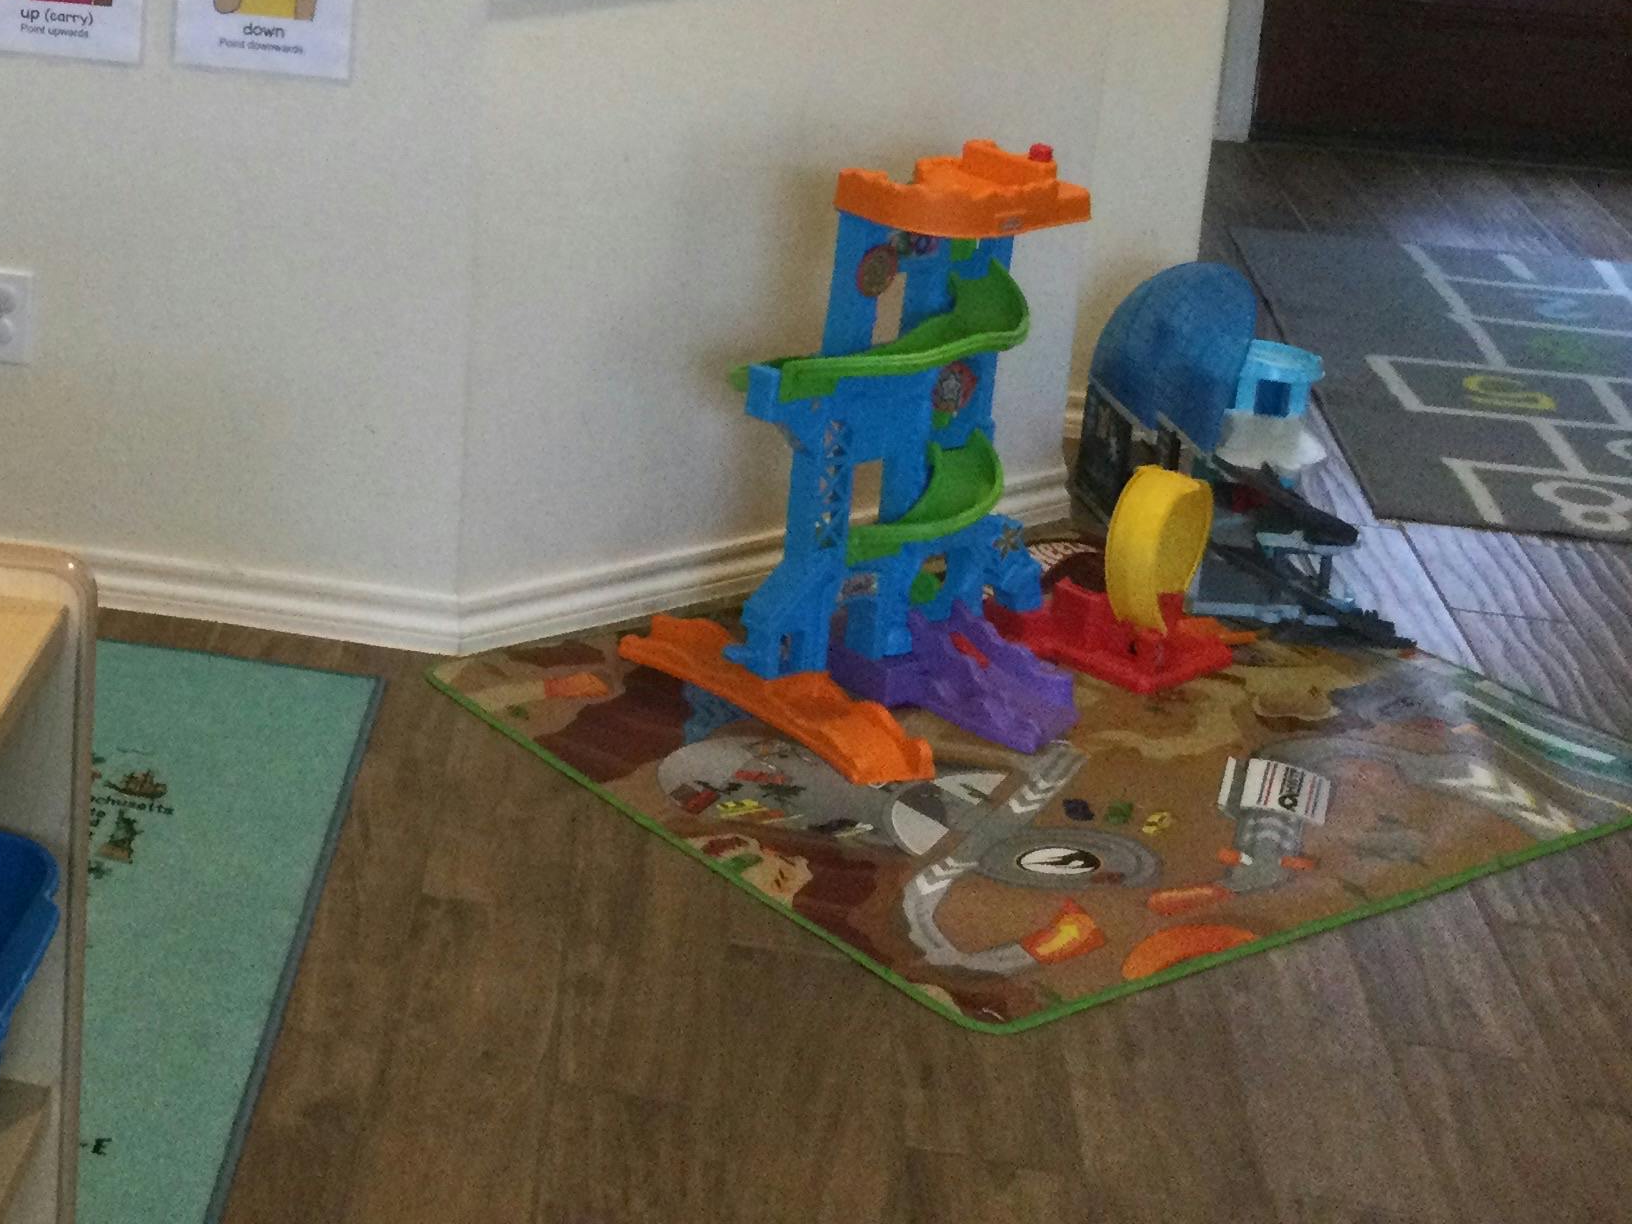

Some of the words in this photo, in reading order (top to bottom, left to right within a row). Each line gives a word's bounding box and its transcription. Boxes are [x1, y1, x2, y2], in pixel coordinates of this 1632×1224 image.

[20, 8, 40, 23] up
[45, 8, 94, 26] (carry)
[20, 23, 45, 34] Point
[243, 21, 285, 38] down
[218, 37, 245, 49] Point
